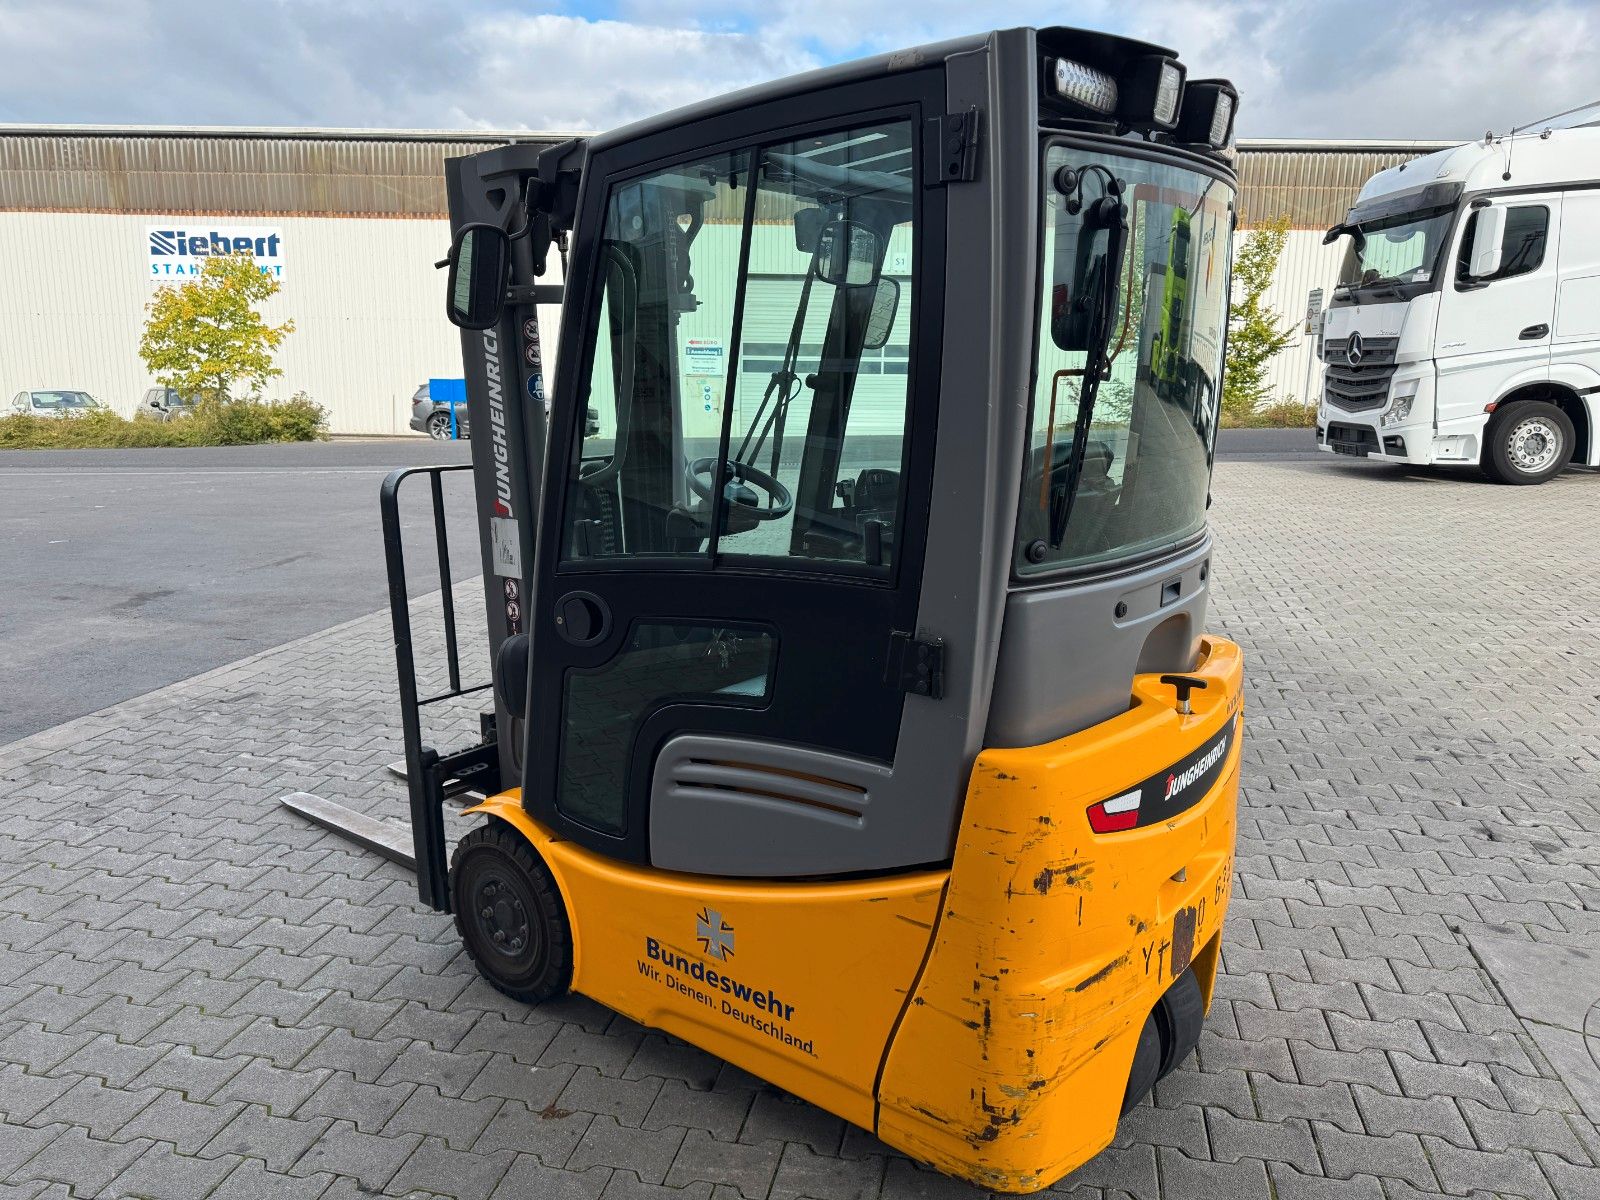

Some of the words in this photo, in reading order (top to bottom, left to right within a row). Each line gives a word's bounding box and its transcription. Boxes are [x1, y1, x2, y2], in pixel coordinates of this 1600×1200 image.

[149, 230, 280, 257] Siebert
[151, 263, 283, 276] STAHKT
[1164, 734, 1227, 801] JUNGHEINRICH
[636, 958, 663, 984] Wir.
[665, 973, 718, 1010] Dienen.
[646, 935, 796, 1022] Bundeswehr
